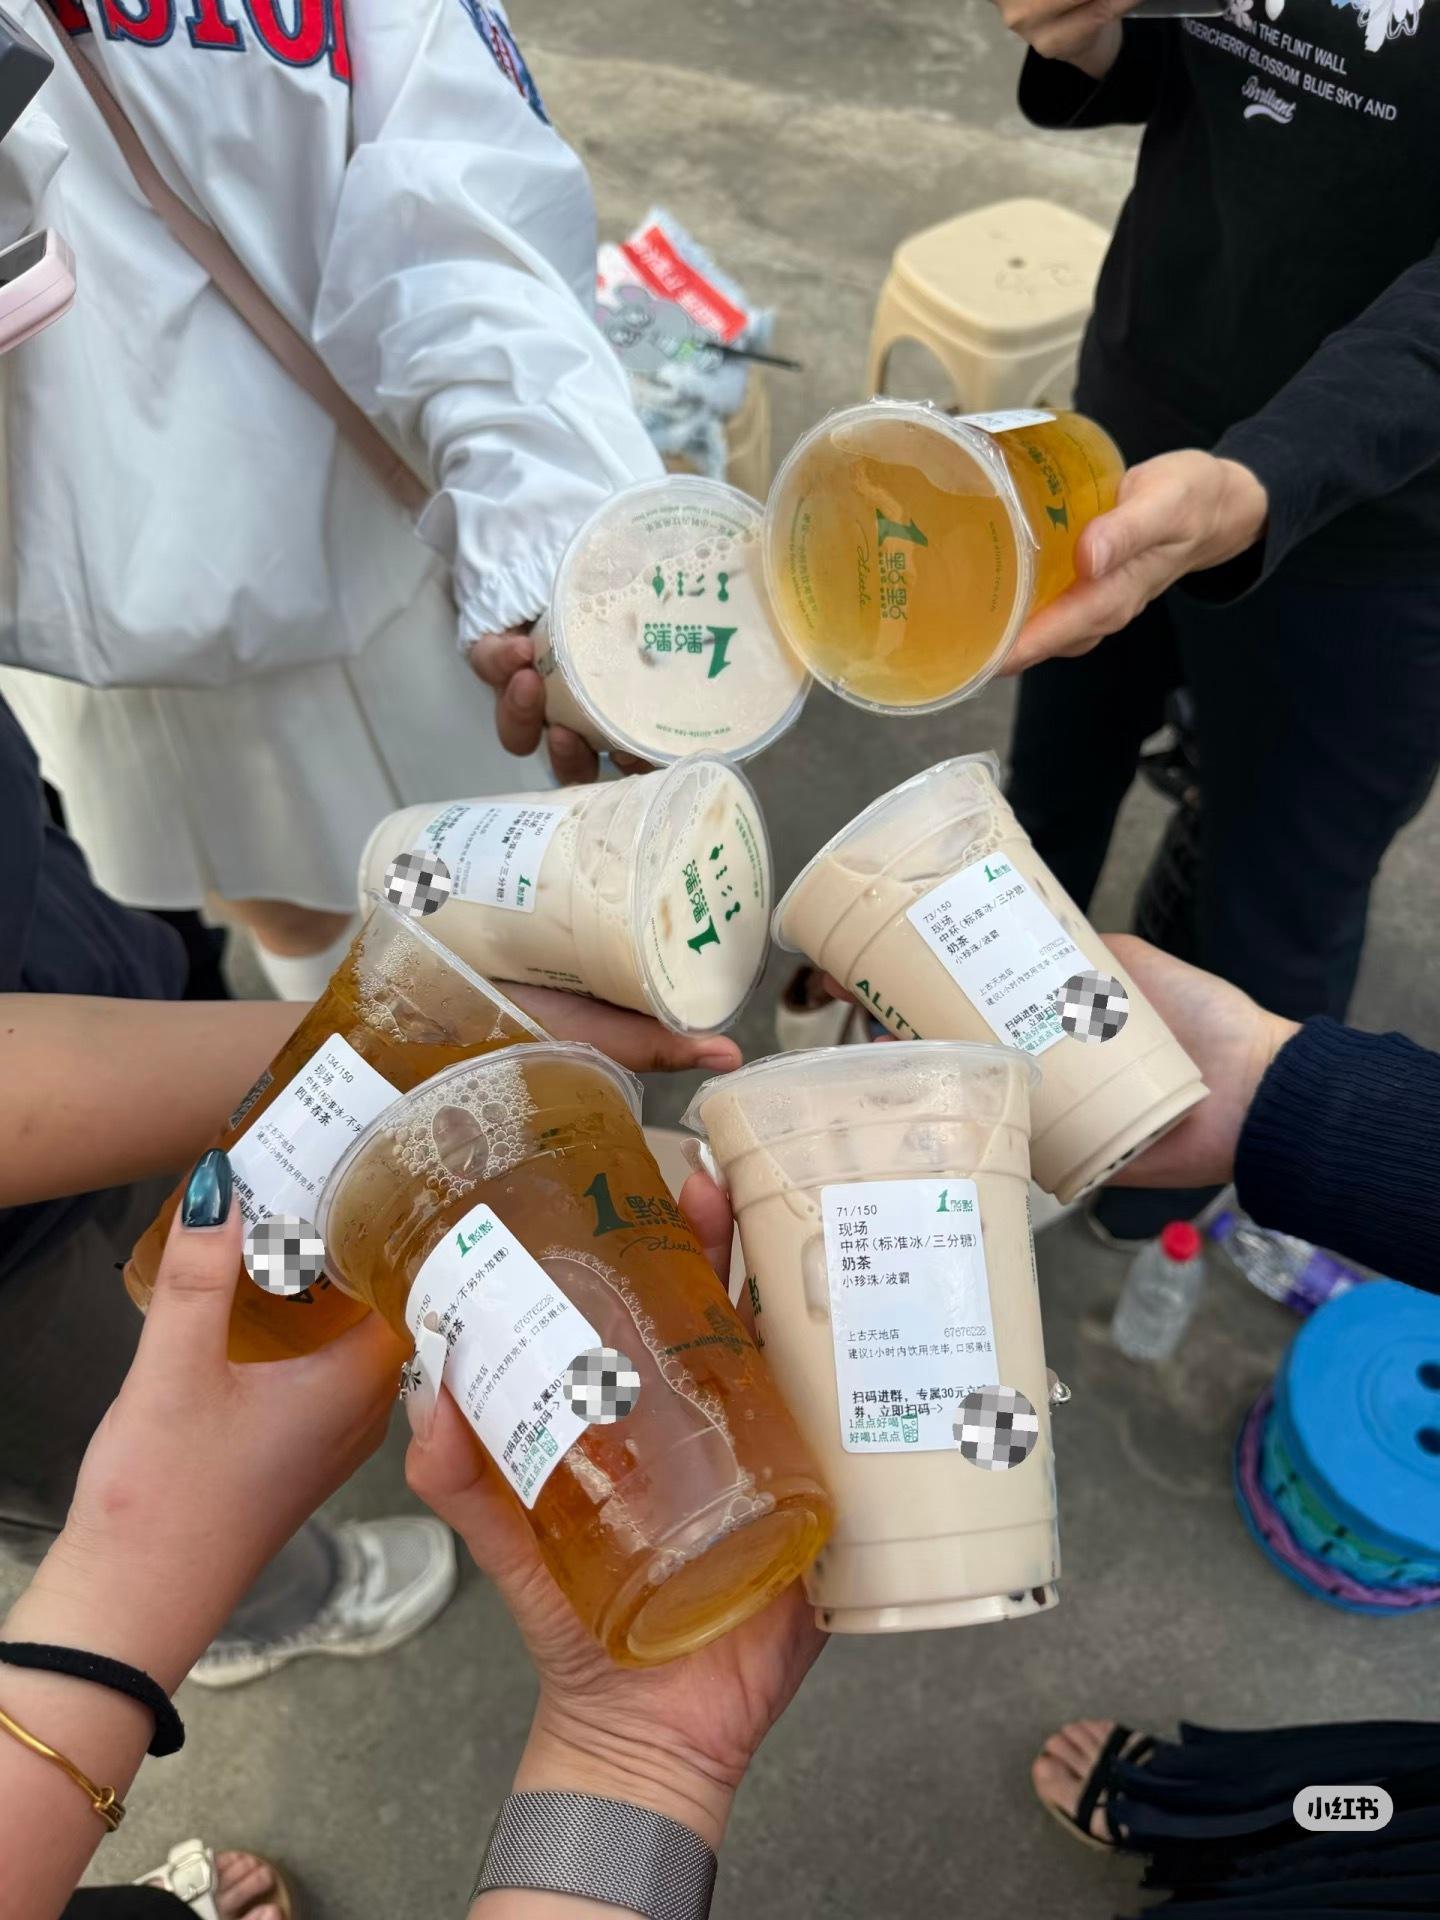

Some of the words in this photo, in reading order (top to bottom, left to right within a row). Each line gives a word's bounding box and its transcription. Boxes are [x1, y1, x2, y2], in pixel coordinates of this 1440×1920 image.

[1259, 23, 1281, 47] THE
[1280, 33, 1313, 60] FLINT
[1314, 46, 1348, 76] WALL
[1248, 47, 1300, 86] BLOSSOM
[1302, 73, 1335, 101] BLUE
[1335, 86, 1363, 111] SKY
[1363, 98, 1398, 122] AND
[931, 915, 955, 935] 现场
[946, 935, 970, 955] 奶茶
[314, 1063, 334, 1087] 现场
[325, 1053, 354, 1084] 134/150
[294, 1086, 332, 1127] 四季春茶
[836, 1204, 878, 1217] 71/150
[838, 1221, 868, 1237] 现场
[840, 1234, 977, 1252] 中杯(标准冰/三分糖)
[841, 1256, 872, 1272] 奶茶
[842, 1272, 910, 1288] 小珍珠/波霸
[847, 1328, 900, 1342] 上古天地店
